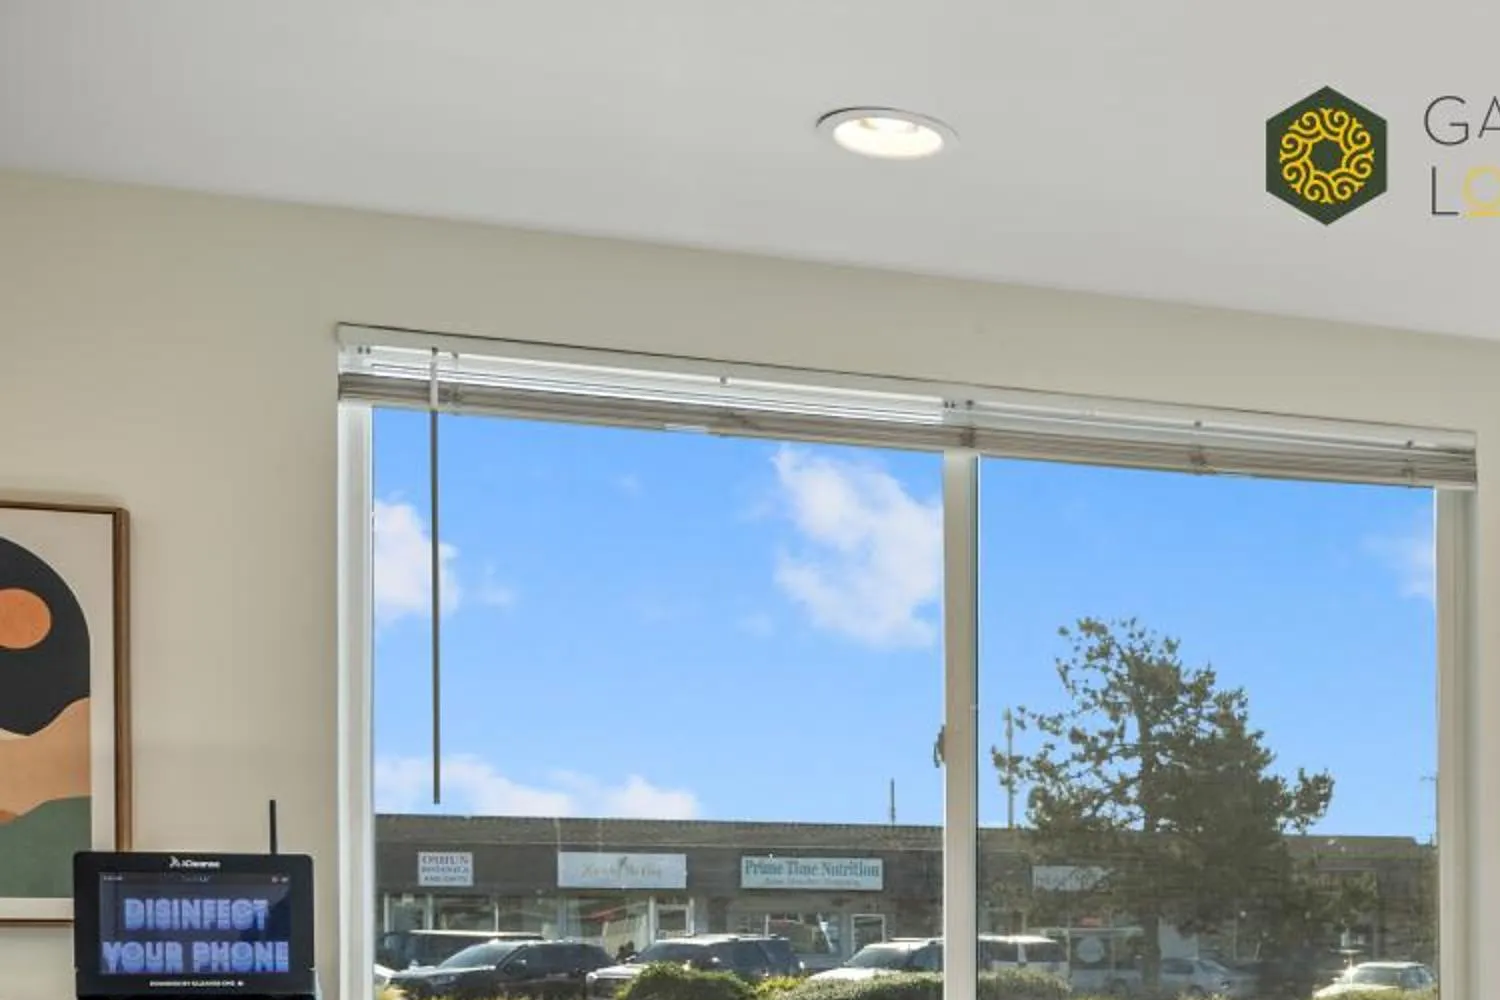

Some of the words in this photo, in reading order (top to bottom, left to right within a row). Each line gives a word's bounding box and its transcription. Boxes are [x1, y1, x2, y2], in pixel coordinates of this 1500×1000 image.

[744, 860, 785, 875] Prime
[786, 860, 819, 875] Time
[821, 860, 880, 877] Nutrition
[124, 899, 270, 931] DISINFECT
[102, 941, 184, 974] YOUR
[193, 941, 290, 974] PHONE
